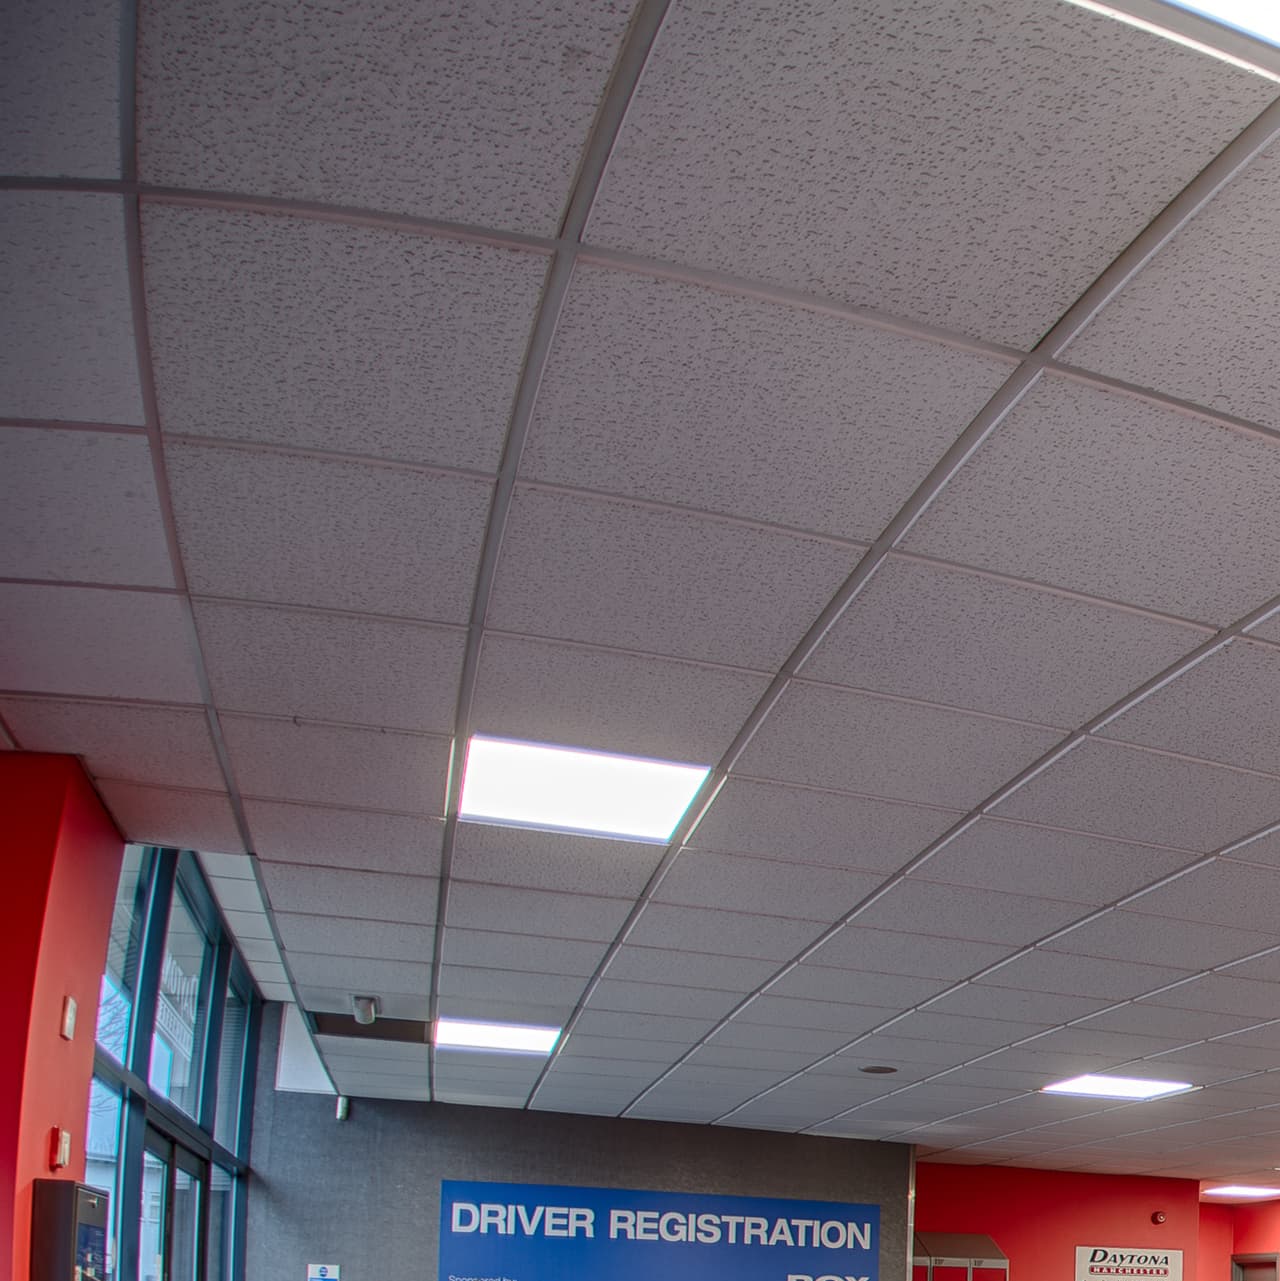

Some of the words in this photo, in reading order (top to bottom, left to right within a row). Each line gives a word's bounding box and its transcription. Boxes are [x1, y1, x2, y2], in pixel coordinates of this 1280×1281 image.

[451, 1201, 595, 1239] DRIVER
[609, 1208, 872, 1250] REGISTRATION
[1089, 1248, 1169, 1266] DAYTONA
